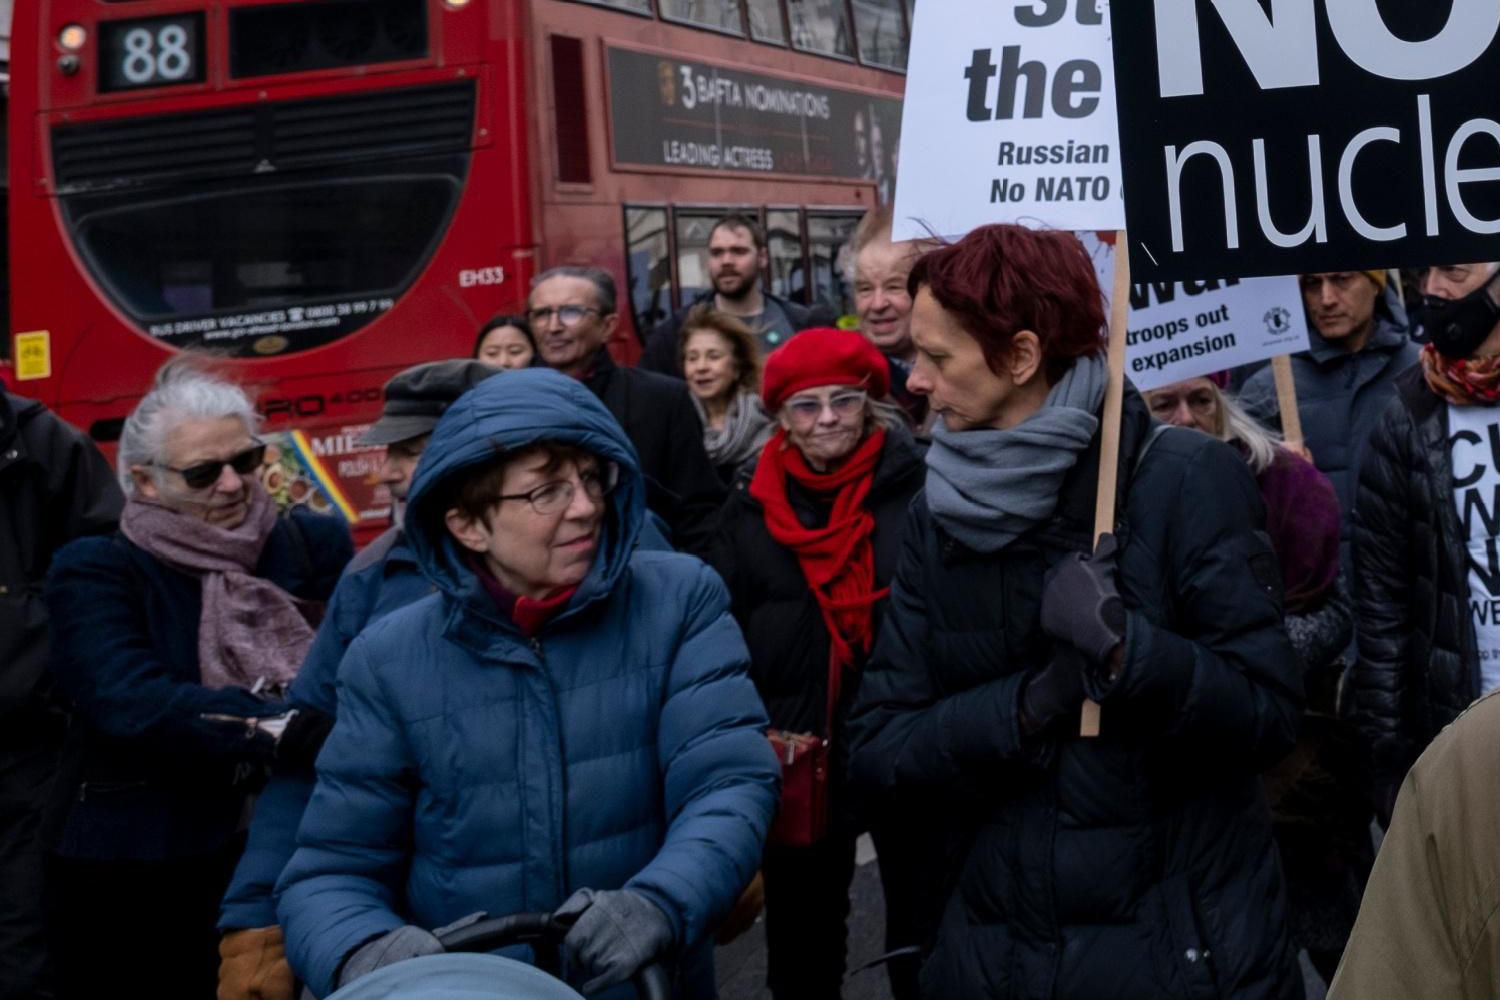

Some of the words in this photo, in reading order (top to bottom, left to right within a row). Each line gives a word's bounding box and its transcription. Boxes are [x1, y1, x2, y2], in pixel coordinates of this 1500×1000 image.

[123, 24, 190, 84] 88
[680, 65, 697, 109] 3
[696, 75, 743, 107] BAFTA
[745, 85, 831, 119] NOMINATIONS
[964, 44, 1101, 122] the
[663, 140, 720, 167] LEADING
[723, 145, 774, 170] ACTRESS
[998, 141, 1109, 166] Russian
[990, 177, 1025, 203] No
[1035, 176, 1110, 202] NATO
[1126, 318, 1188, 346] troops
[1196, 304, 1230, 328] out
[1132, 333, 1236, 372] expansion
